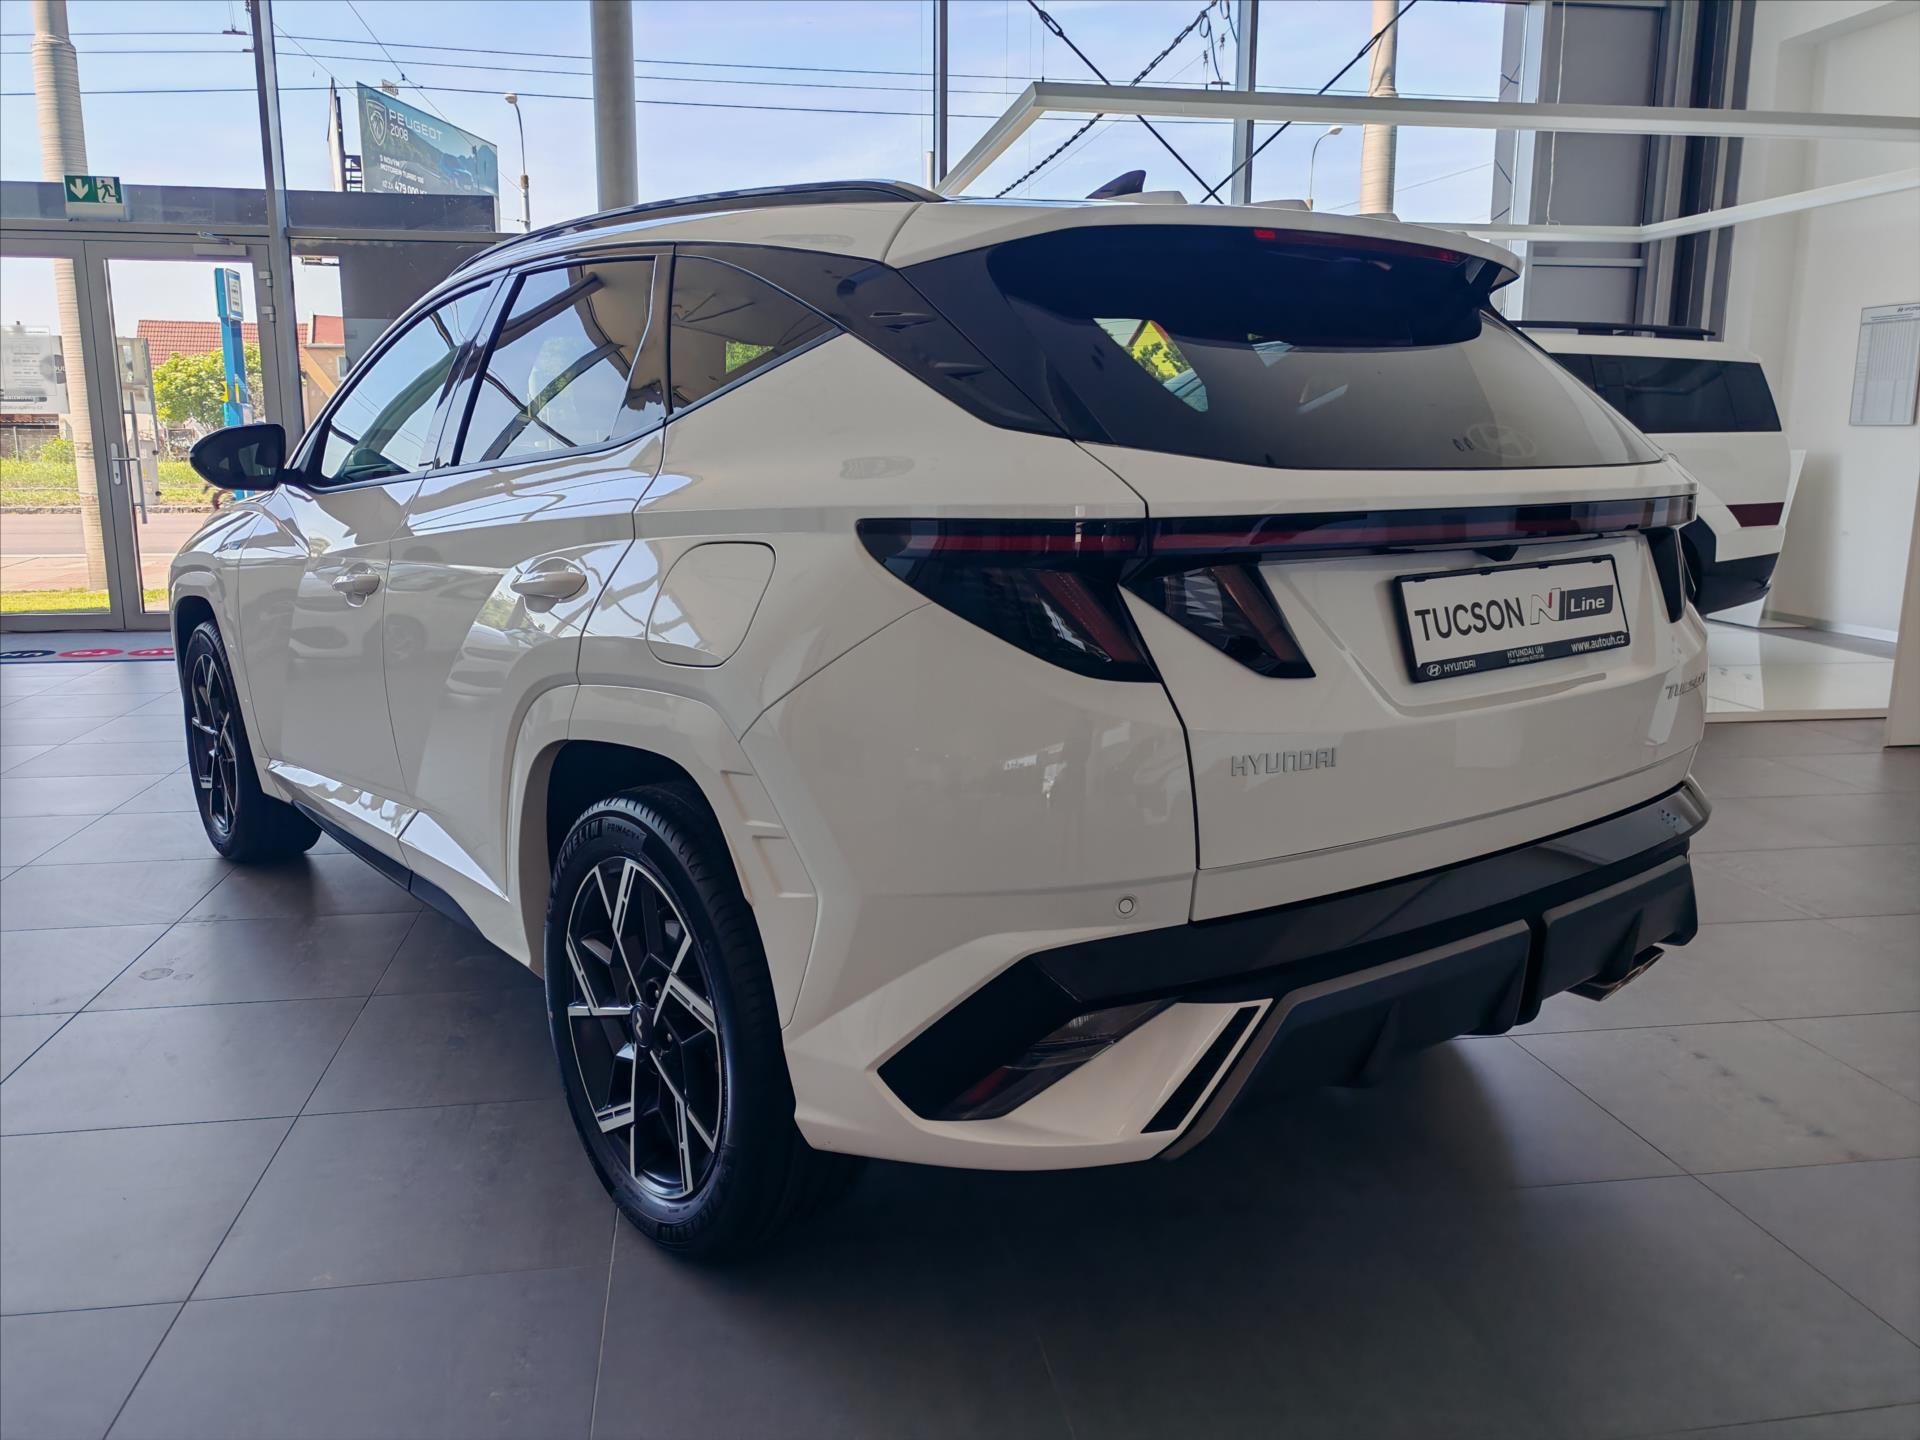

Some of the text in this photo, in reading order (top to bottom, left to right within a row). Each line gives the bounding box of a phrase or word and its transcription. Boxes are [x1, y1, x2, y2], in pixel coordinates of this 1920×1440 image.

[388, 109, 444, 142] PEUGEOT
[390, 124, 409, 141] 2008
[395, 181, 407, 194] 479
[1414, 596, 1525, 641] TUCSON
[1570, 595, 1606, 613] Line
[1507, 646, 1534, 659] HYUNDAI
[1571, 634, 1626, 653] www.autouh.cz
[1443, 658, 1477, 674] HYUNDAI
[1231, 747, 1336, 777] HYUNDAI
